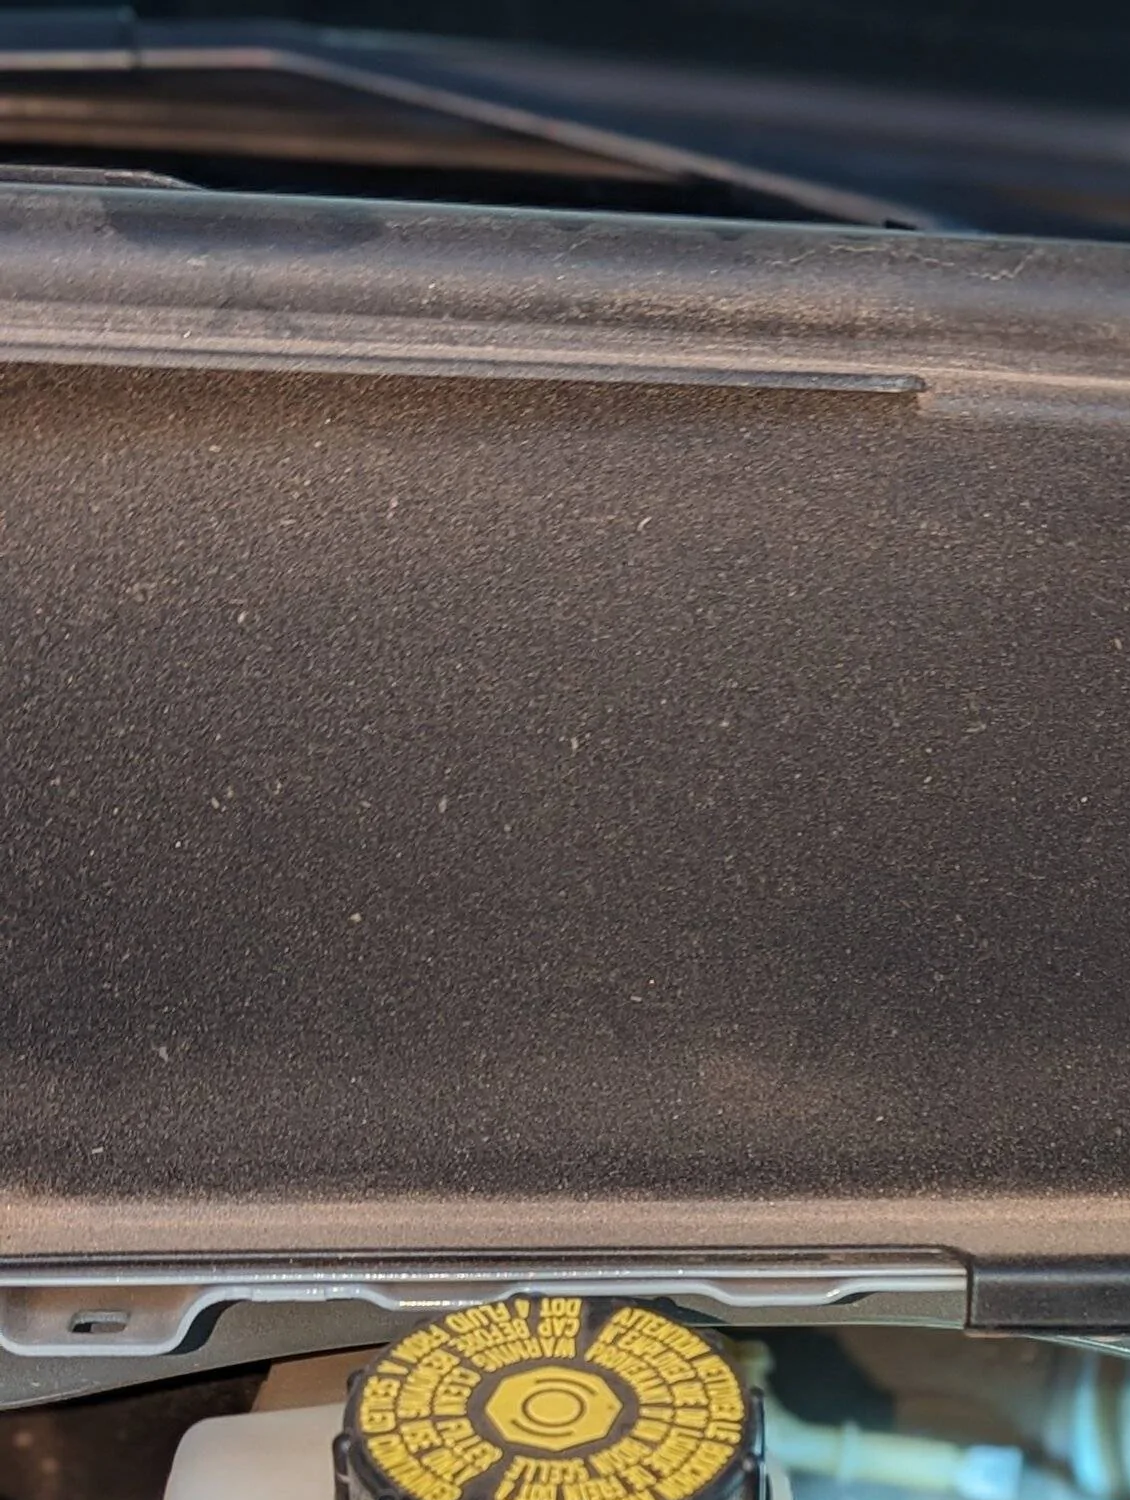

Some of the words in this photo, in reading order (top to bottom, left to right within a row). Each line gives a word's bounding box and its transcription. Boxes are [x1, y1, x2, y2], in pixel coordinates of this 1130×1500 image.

[445, 1302, 511, 1334] FLUID
[514, 1299, 530, 1319] 4
[540, 1298, 582, 1317] DOT
[391, 1324, 451, 1363] FROM
[448, 1318, 530, 1357] BEFORE
[538, 1317, 580, 1338] CAP
[611, 1307, 711, 1360] ATTENTION
[376, 1360, 409, 1376] A
[470, 1336, 577, 1372] WARNING
